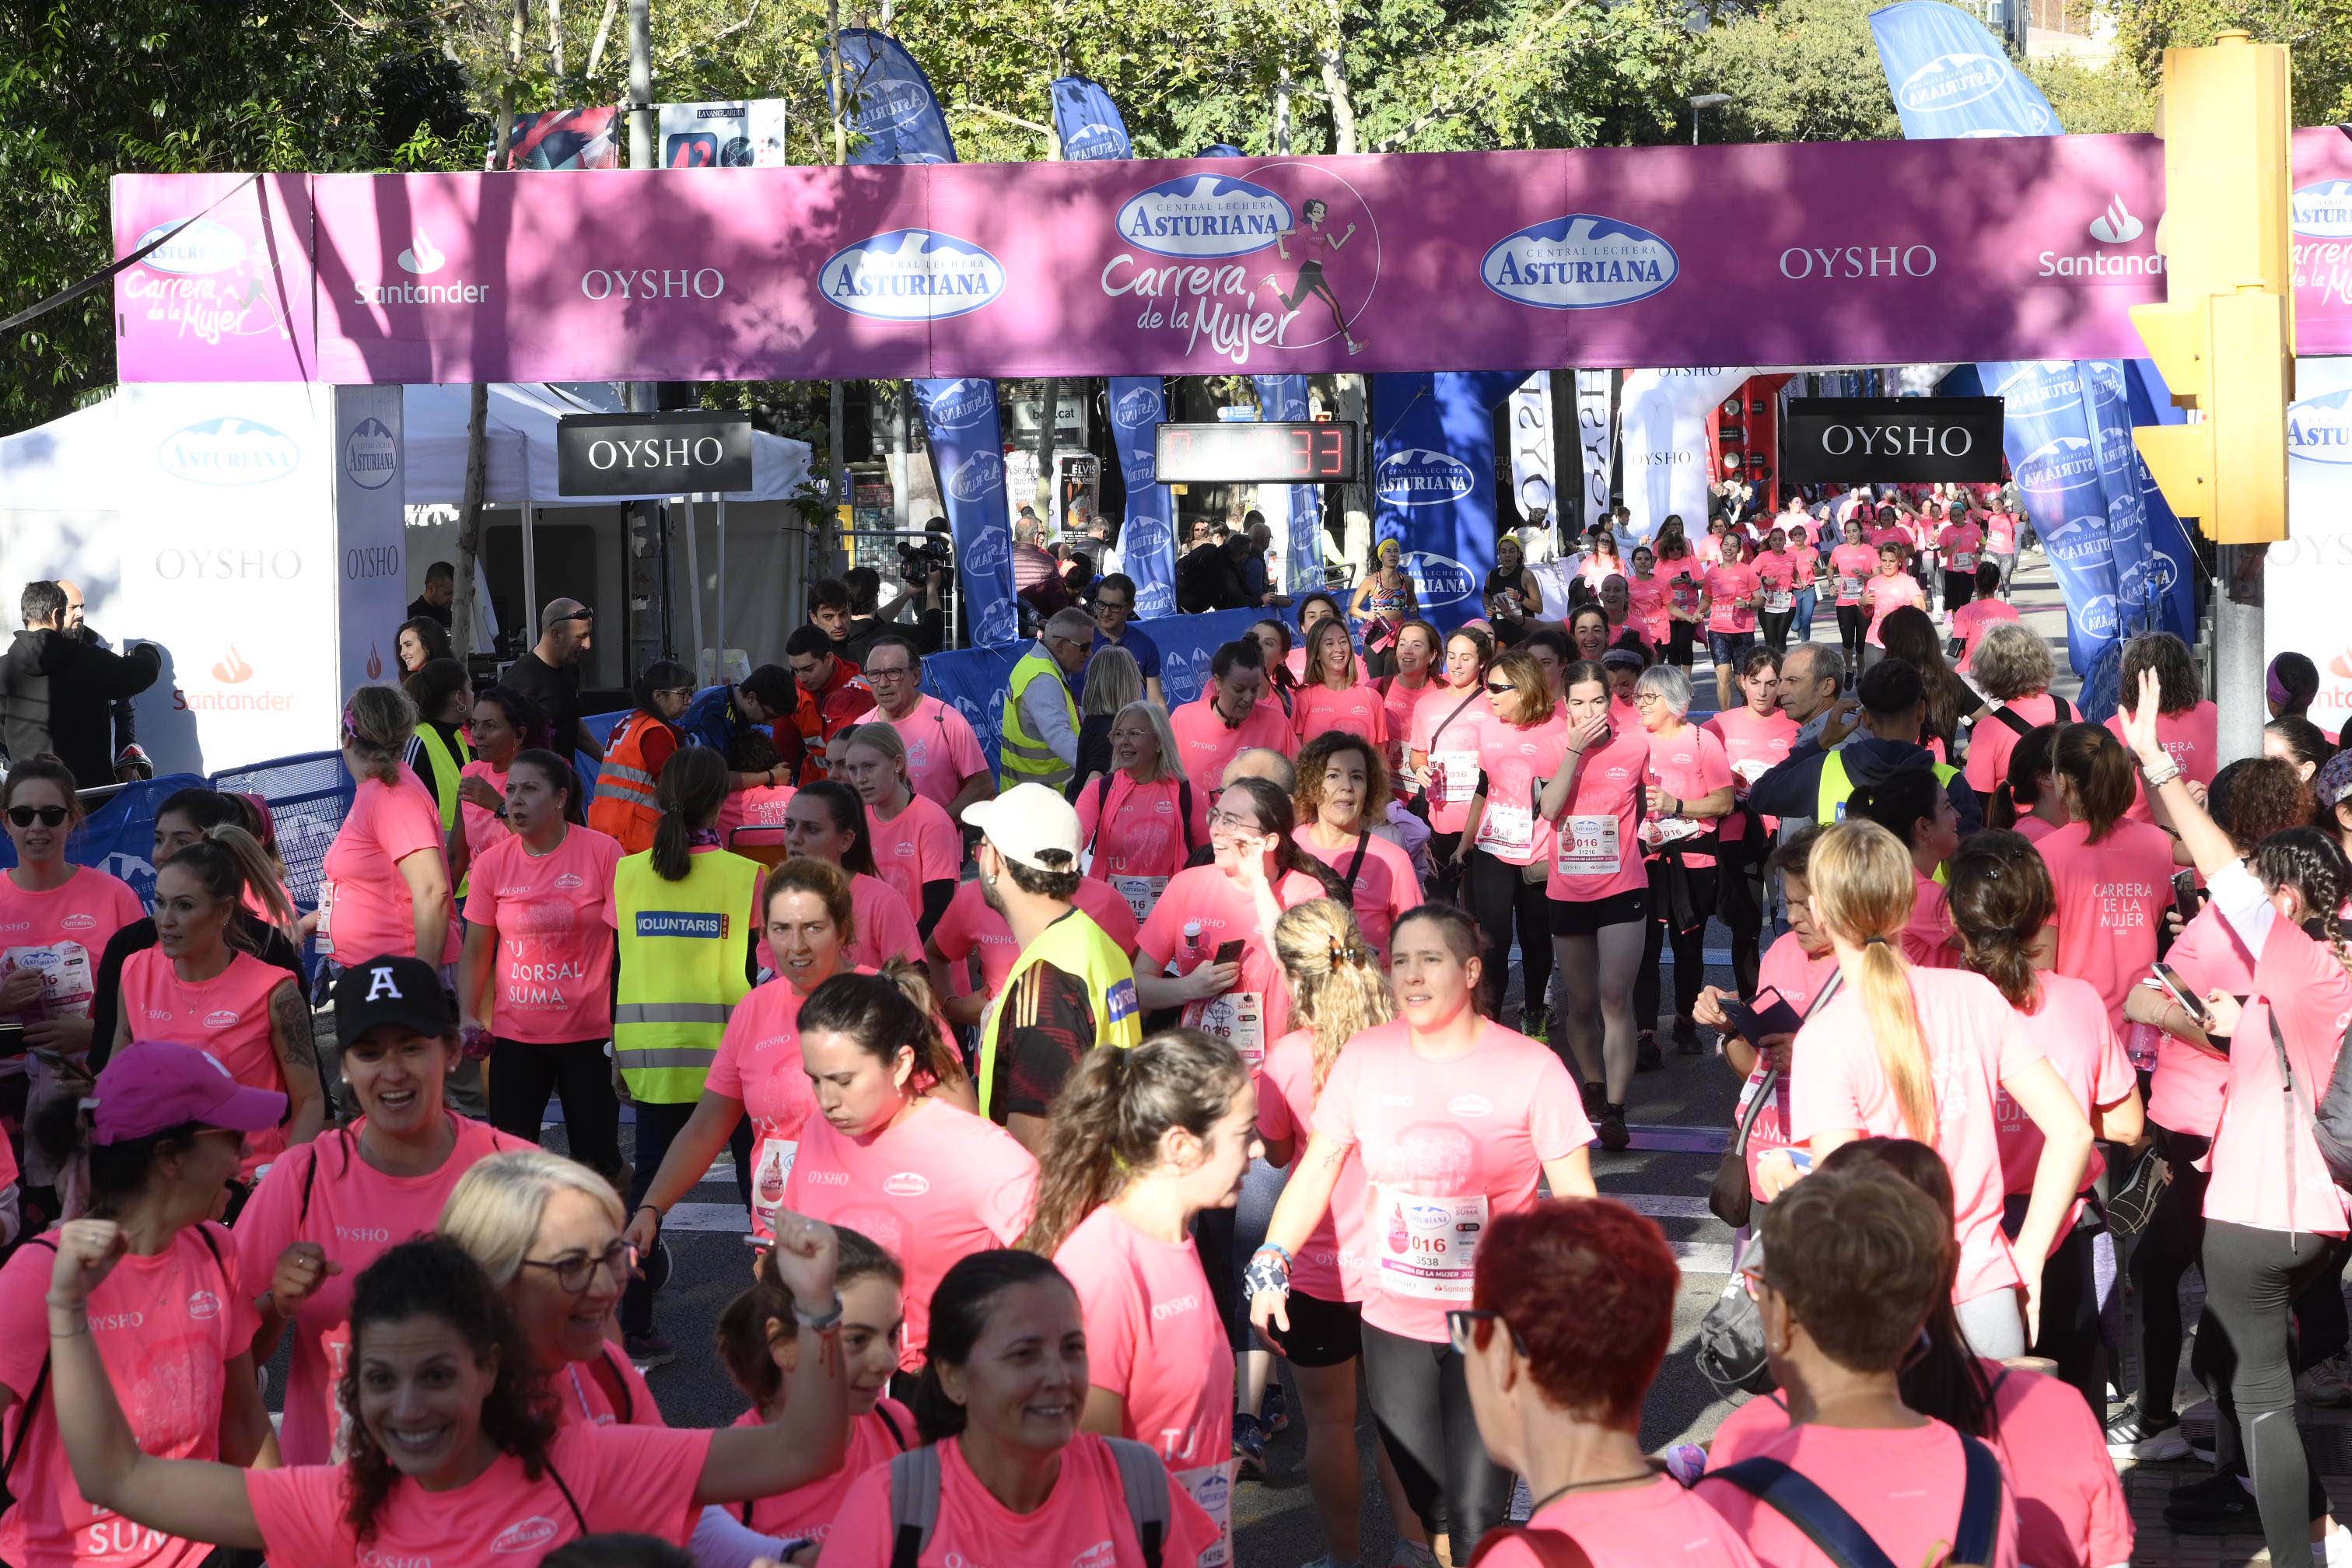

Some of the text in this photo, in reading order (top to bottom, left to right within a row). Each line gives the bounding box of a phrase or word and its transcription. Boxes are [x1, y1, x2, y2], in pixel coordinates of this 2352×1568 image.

[1157, 201, 1275, 212] CENTRAL LECHERA
[1129, 205, 1279, 237] ASTURIANA
[1527, 244, 1657, 257] CENTRAL LECHERA
[1496, 250, 1664, 286] ASTURIANA
[1780, 244, 1937, 279] OYSHO
[2039, 250, 2168, 277] Santand
[124, 269, 218, 300] Carrera
[582, 268, 724, 300] OYSHO
[833, 262, 991, 299] ASTURIANA
[1101, 254, 1247, 299] Carrera
[354, 281, 489, 306] Santander
[147, 301, 165, 320] de
[178, 296, 251, 345] Mujer
[1137, 291, 1301, 365] de la Mujer
[1822, 424, 1973, 457] OYSHO
[349, 447, 394, 471] ASTURIANA
[588, 437, 723, 469] OYSHO
[1071, 464, 1097, 474] ELVIS
[1379, 470, 1468, 493] ASTURIANA
[156, 548, 302, 579] OYSHO
[348, 544, 399, 580] OYSHO
[1414, 576, 1468, 593] RIANA
[173, 689, 294, 711] Santander
[1191, 740, 1217, 751] OYSHO
[2163, 741, 2196, 752] RERA
[750, 800, 787, 813] CARRER
[760, 810, 775, 819] DE
[760, 814, 786, 826] MUJE
[1577, 838, 1598, 847] 016
[1664, 829, 1682, 838] 016
[1108, 856, 1127, 870] TU
[499, 885, 530, 895] OYSHO
[2092, 882, 2152, 898] CARRERA
[2103, 898, 2141, 912] DE LA
[0, 921, 30, 931] YSHO
[62, 917, 96, 927] ASTURIANA
[637, 918, 719, 931] VOLUNTARIS
[1191, 917, 1226, 929] OYSHO
[2100, 912, 2144, 928] MUJER
[982, 933, 1018, 945] OYSHO
[512, 961, 583, 982] DORSAL
[365, 966, 403, 1003] A
[509, 985, 565, 1005] SUMA
[754, 1033, 791, 1052] OYSHO
[809, 1171, 849, 1185] OYSHO
[1412, 1236, 1447, 1252] 016
[1316, 1251, 1365, 1269] OYSHO
[1153, 1294, 1199, 1320] OYSHO
